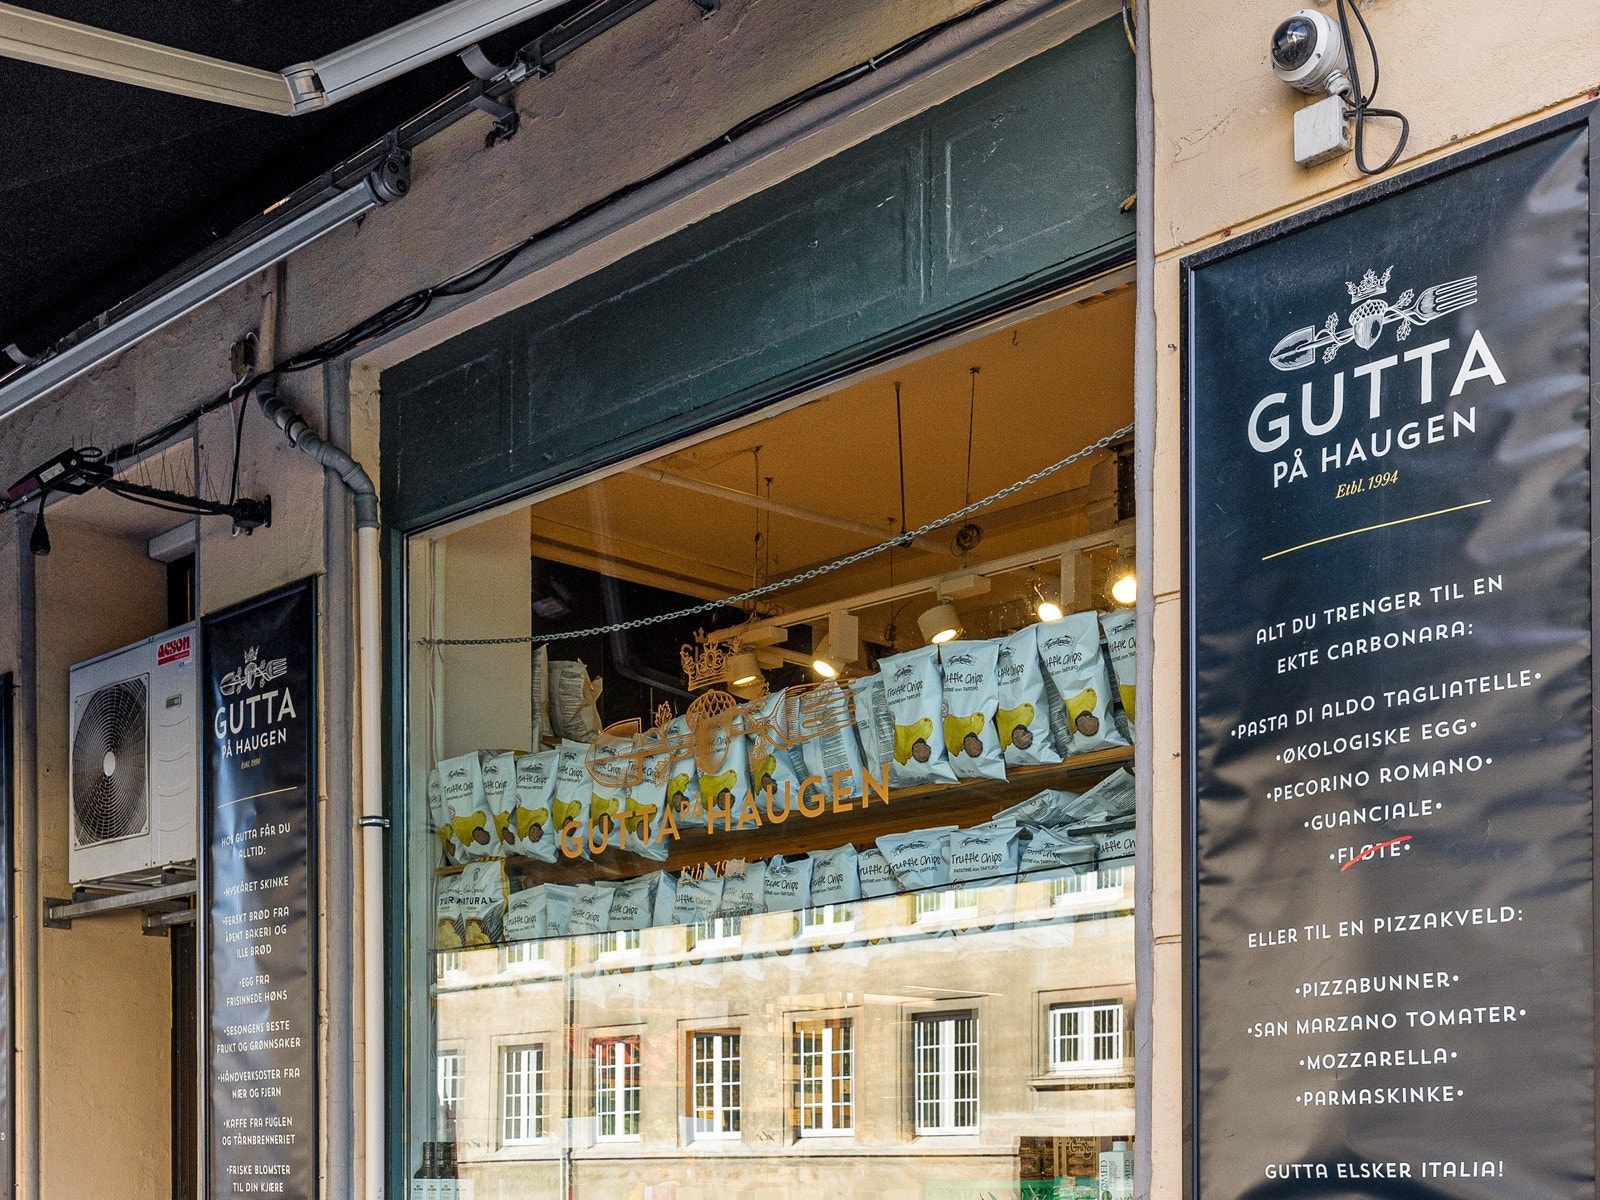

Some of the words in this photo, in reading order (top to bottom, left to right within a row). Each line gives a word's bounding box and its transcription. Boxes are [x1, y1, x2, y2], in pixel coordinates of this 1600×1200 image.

[1248, 329, 1507, 453] GUTTA
[1273, 448, 1308, 488] PÅ
[1321, 406, 1476, 472] HAUGEN
[1368, 470, 1399, 491] 1994
[1256, 622, 1285, 645] ALT
[1292, 614, 1316, 635] DU
[1323, 591, 1421, 625] TRENGER
[1430, 582, 1464, 604] TIL
[1473, 575, 1503, 595] EN
[1277, 649, 1319, 674] EKTE
[1327, 621, 1474, 660] CARBONARA:
[214, 687, 297, 740] GUTTA
[1296, 708, 1313, 725] DI
[1321, 695, 1375, 719] ALDO
[221, 739, 233, 760] PÅ
[236, 727, 287, 755] HAUGEN
[561, 804, 681, 859] GUTTA
[680, 791, 705, 822] PÅ
[707, 762, 889, 835] HAUGEN
[235, 826, 258, 844] GUTTA
[260, 822, 277, 836] FÅR
[278, 822, 291, 834] DU
[951, 852, 979, 865] Truffle
[980, 852, 1003, 865] Chips
[260, 875, 289, 890] SKINKE
[249, 909, 270, 921] BRØD
[273, 906, 289, 917] FRA
[245, 926, 272, 941] BAKERI
[274, 924, 287, 935] OG
[1248, 928, 1298, 948] ELLER
[1304, 924, 1331, 940] TIL
[1339, 920, 1364, 937] EN
[1374, 906, 1524, 934] PIZZAKVELD:
[236, 946, 249, 959] ILLE
[250, 944, 272, 955] BRØD
[255, 974, 270, 985] FRA
[226, 992, 263, 1007] FRISINNEDE
[264, 989, 288, 1002] HØNS
[266, 1020, 290, 1031] BESTE
[1296, 1013, 1397, 1035] MARZANO
[216, 1042, 236, 1054] FRUKT
[238, 1041, 248, 1052] OG
[249, 1037, 301, 1051] GRØNNSAKER
[284, 1067, 300, 1078] FRA
[232, 1088, 248, 1099] NÆR
[249, 1088, 260, 1098] OG
[261, 1086, 282, 1097] FJERN
[250, 1117, 263, 1128] FRA
[265, 1116, 293, 1128] FUGLEN
[222, 1135, 232, 1146] OG
[233, 1131, 296, 1146] TÅRNBRENNERIET
[254, 1164, 291, 1175] BLOMSTER
[1264, 1163, 1328, 1179] GUTTA
[1337, 1162, 1412, 1179] ELSKER
[1421, 1160, 1504, 1178] ITALIA!
[233, 1182, 244, 1192] TIL
[245, 1182, 258, 1192] DIN
[260, 1182, 284, 1192] KJÆRE
